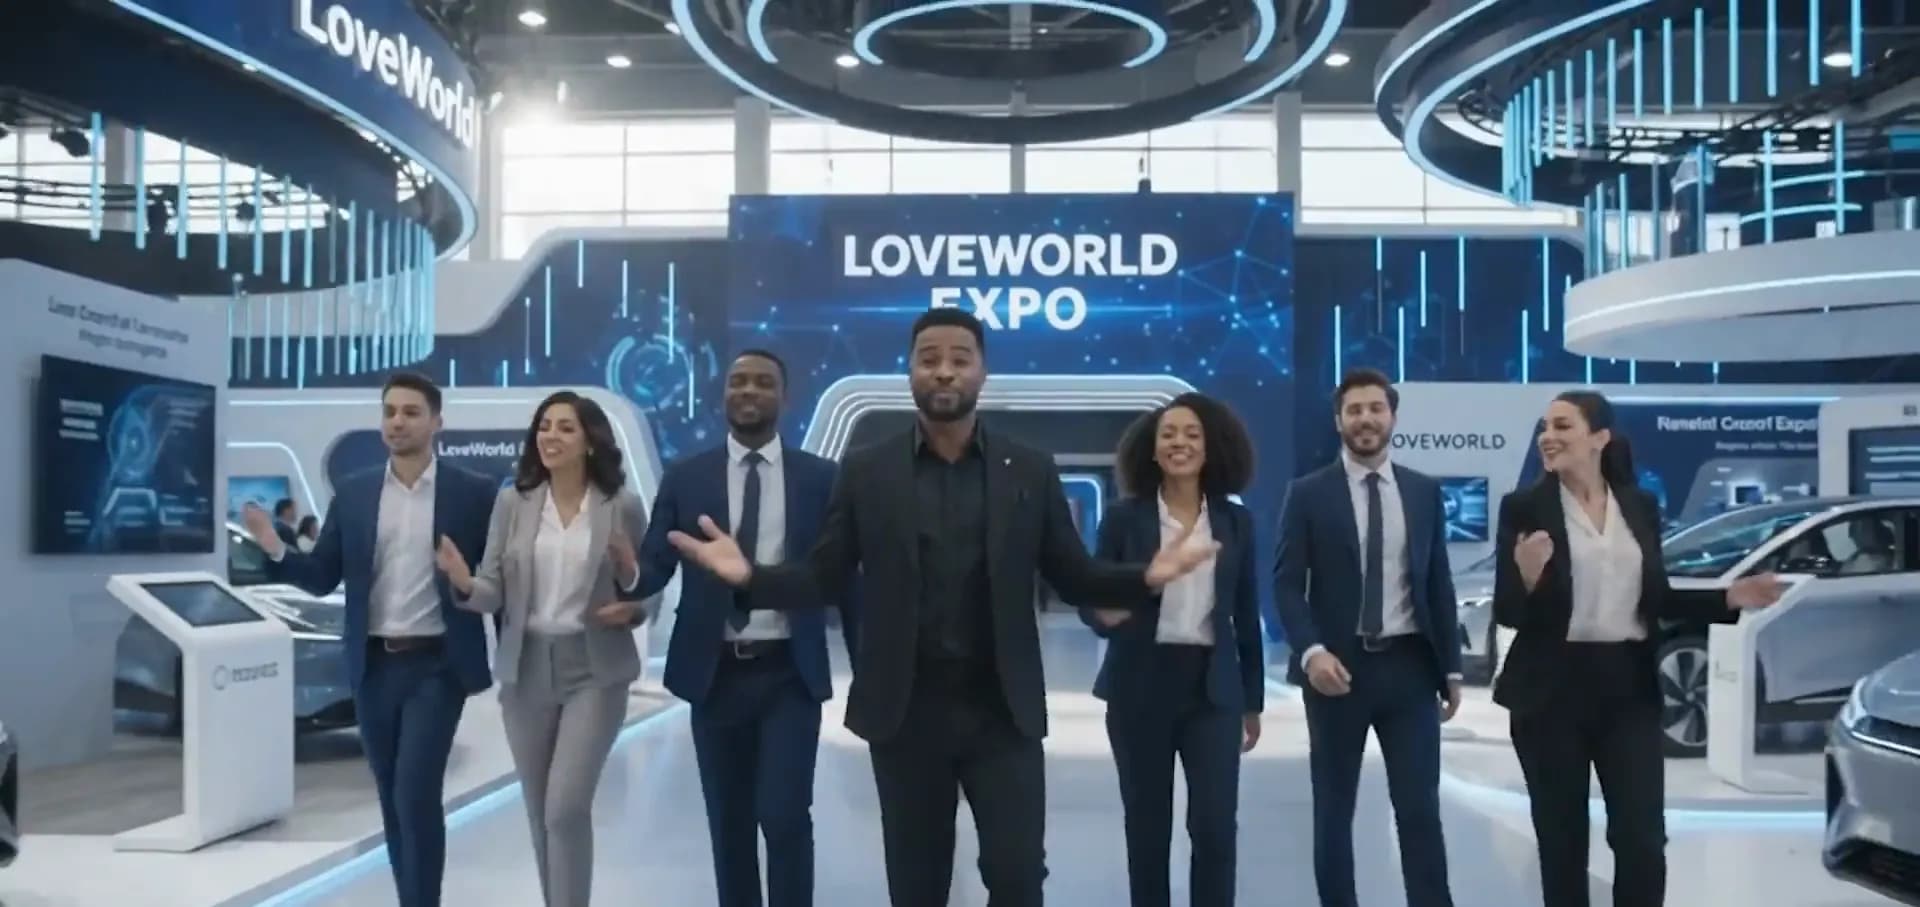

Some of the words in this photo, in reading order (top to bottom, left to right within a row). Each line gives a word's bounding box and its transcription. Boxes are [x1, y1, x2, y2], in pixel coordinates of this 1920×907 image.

[298, 0, 475, 149] LoveWorld
[843, 233, 1178, 277] LOVEWORLD
[1391, 433, 1506, 450] OVEWORLD
